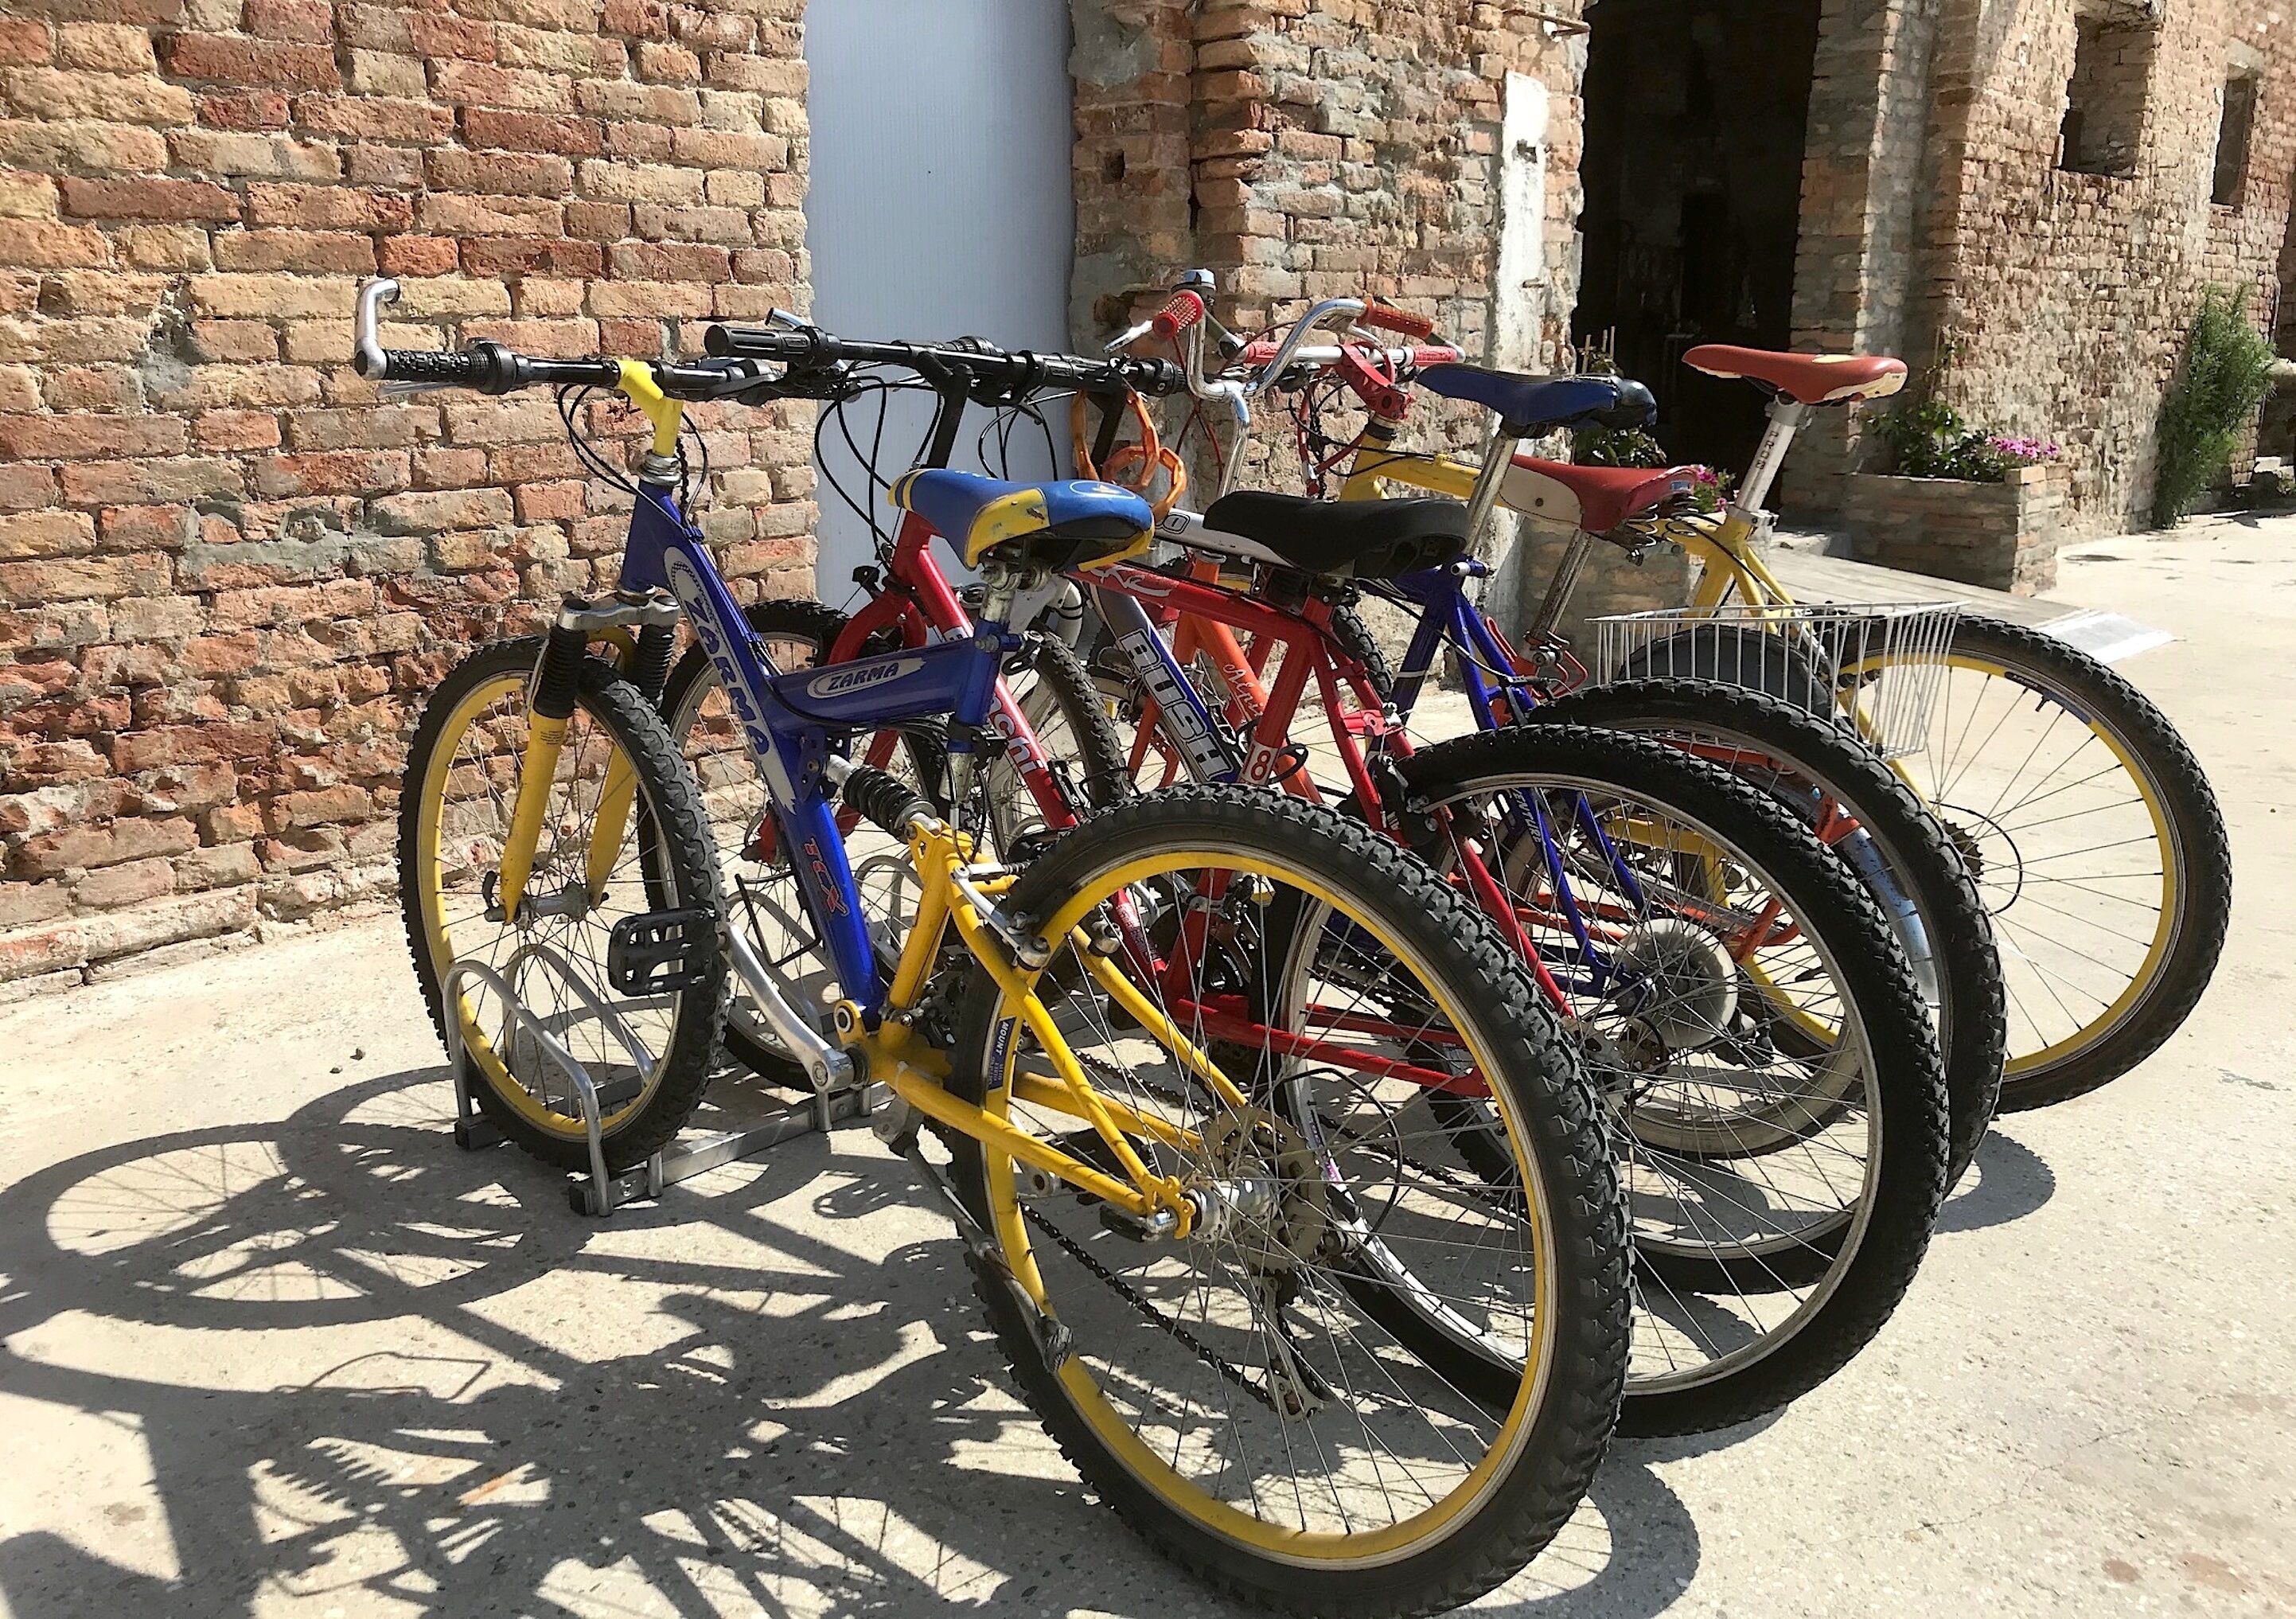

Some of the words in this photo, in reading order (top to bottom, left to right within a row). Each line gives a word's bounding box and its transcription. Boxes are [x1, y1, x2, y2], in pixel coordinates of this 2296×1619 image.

[684, 596, 770, 755] ZARMA
[828, 662, 899, 691] ZARMA
[1120, 630, 1232, 781] RUSH
[803, 837, 848, 914] TCX
[996, 1020, 1010, 1055] MOUNT
